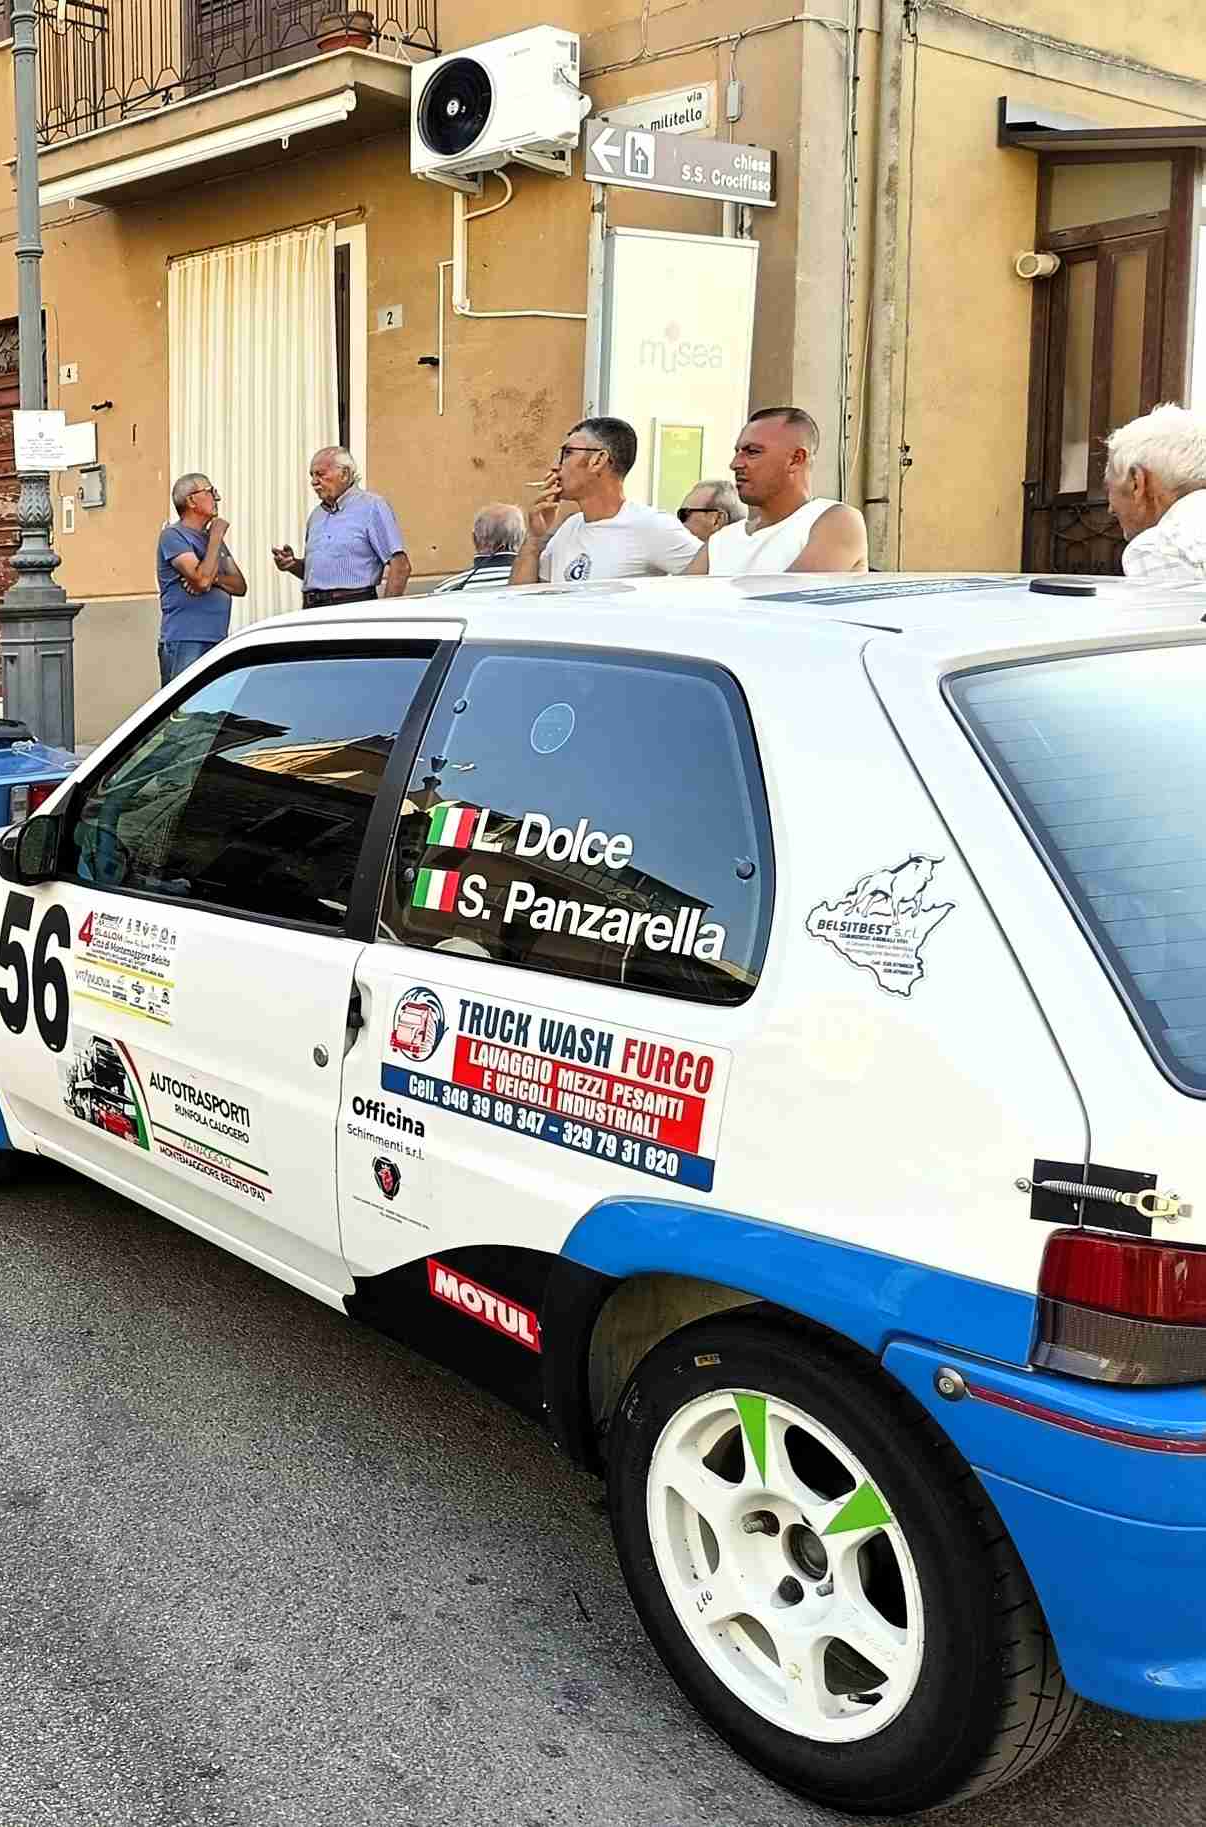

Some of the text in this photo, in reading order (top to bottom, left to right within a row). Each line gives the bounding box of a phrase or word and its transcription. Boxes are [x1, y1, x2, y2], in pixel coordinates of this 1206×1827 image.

[686, 90, 703, 103] via
[650, 108, 703, 132] militello
[681, 164, 772, 193] S.S. Crocifisso
[733, 153, 771, 172] chiesa
[386, 311, 394, 325] 2
[66, 367, 72, 379] 4
[470, 808, 634, 870] L. Dolce
[457, 873, 727, 961] S. Panzarella
[817, 919, 892, 936] BELSITBEST
[458, 999, 715, 1094] TRUCK WASH FURCO
[149, 1071, 251, 1128] AUTOTRASPORTI
[467, 1039, 684, 1121] LAVAGGIO MEZZI PESANTI
[174, 1104, 250, 1144] RUNFOLA CALOGERO
[352, 1096, 425, 1138] Officina
[408, 1074, 439, 1103] Cell.
[442, 1084, 469, 1110] 348
[472, 1093, 491, 1117] 39
[516, 1107, 546, 1135] 347
[562, 1121, 593, 1150] 329
[597, 1130, 618, 1157] 79
[620, 1140, 641, 1165] 31
[644, 1146, 679, 1176] 820
[482, 1071, 661, 1139] E VEICOLI INDUSTRIALI
[346, 1123, 425, 1161] Schimmenti s.r.l.
[159, 1144, 266, 1202] MONTEMAGGIORE BELSITO (PA)
[434, 1267, 535, 1344] MOTUL
